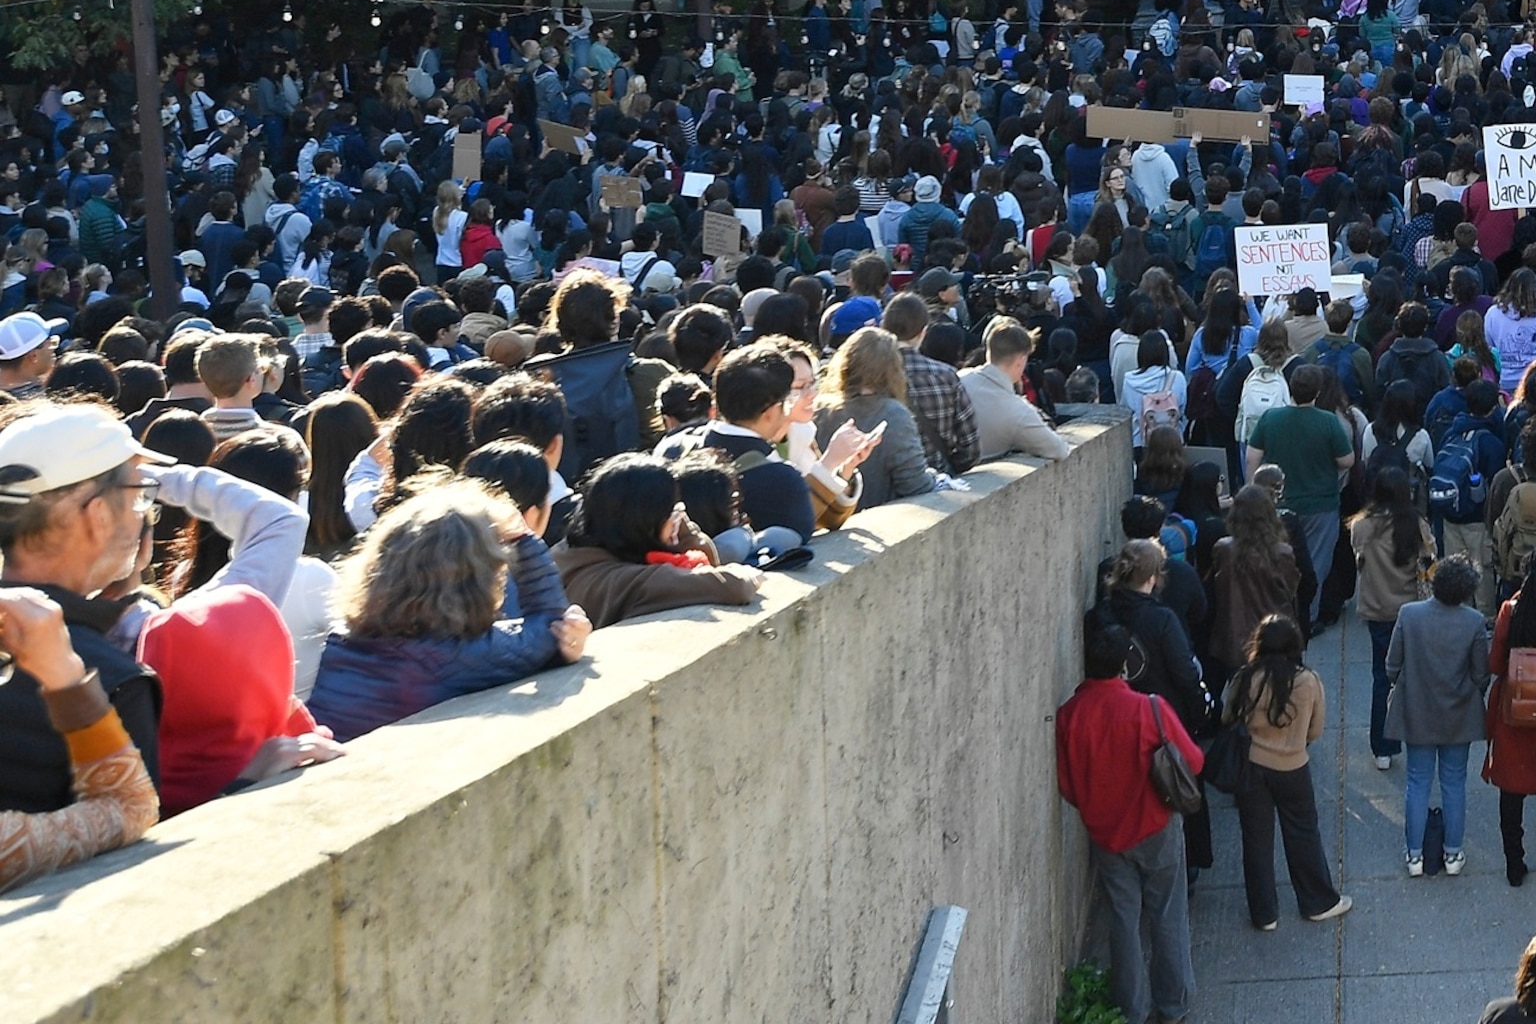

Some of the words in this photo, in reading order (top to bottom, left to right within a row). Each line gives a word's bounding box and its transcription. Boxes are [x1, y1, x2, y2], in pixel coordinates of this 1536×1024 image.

[1491, 180, 1527, 206] Jane
[1250, 230, 1271, 242] WE
[1276, 228, 1310, 241] WANT
[1240, 241, 1328, 265] SENTENCES
[1276, 264, 1294, 275] NOT
[1262, 274, 1317, 292] ESSAYS
